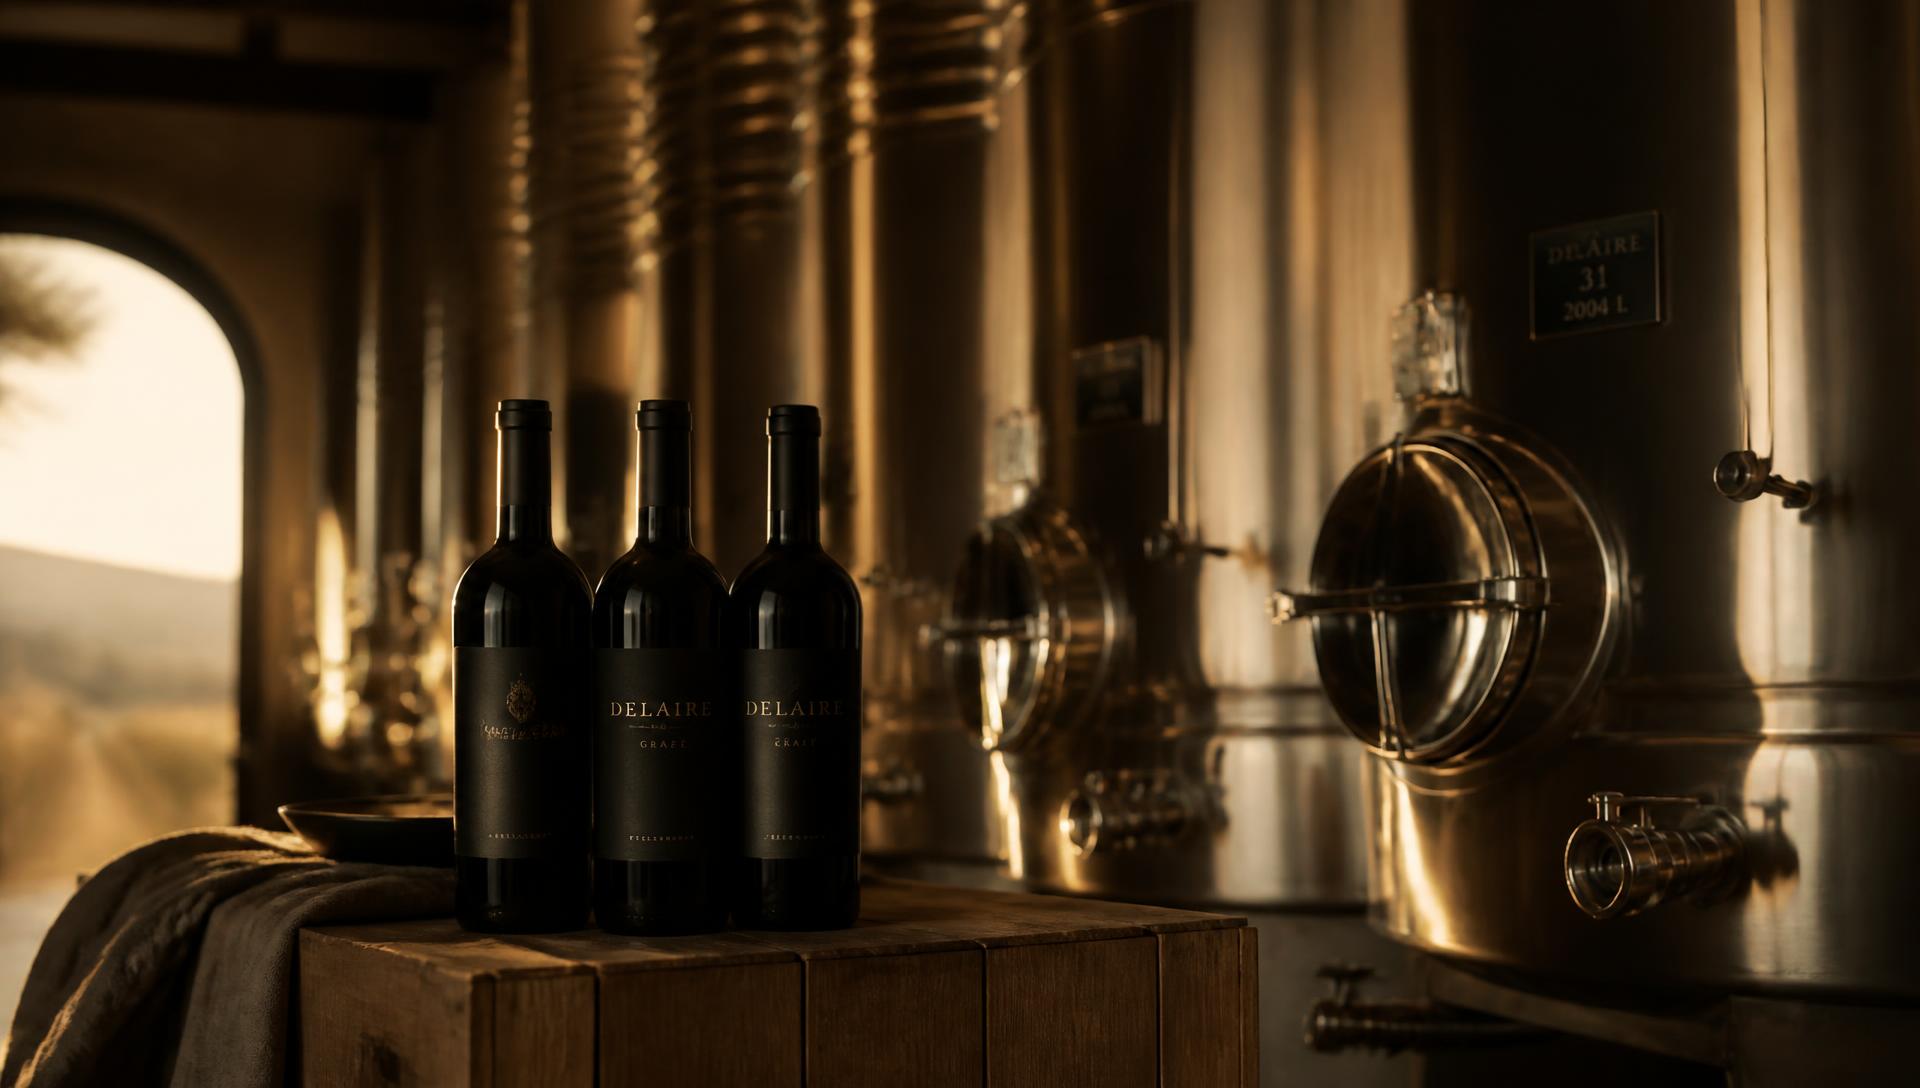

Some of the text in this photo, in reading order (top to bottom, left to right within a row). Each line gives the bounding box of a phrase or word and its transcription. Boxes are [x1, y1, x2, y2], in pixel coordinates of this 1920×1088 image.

[1578, 264, 1608, 292] 31
[1562, 296, 1609, 322] 2004
[610, 701, 712, 717] DELAIRE
[746, 700, 847, 716] DELAIRE
